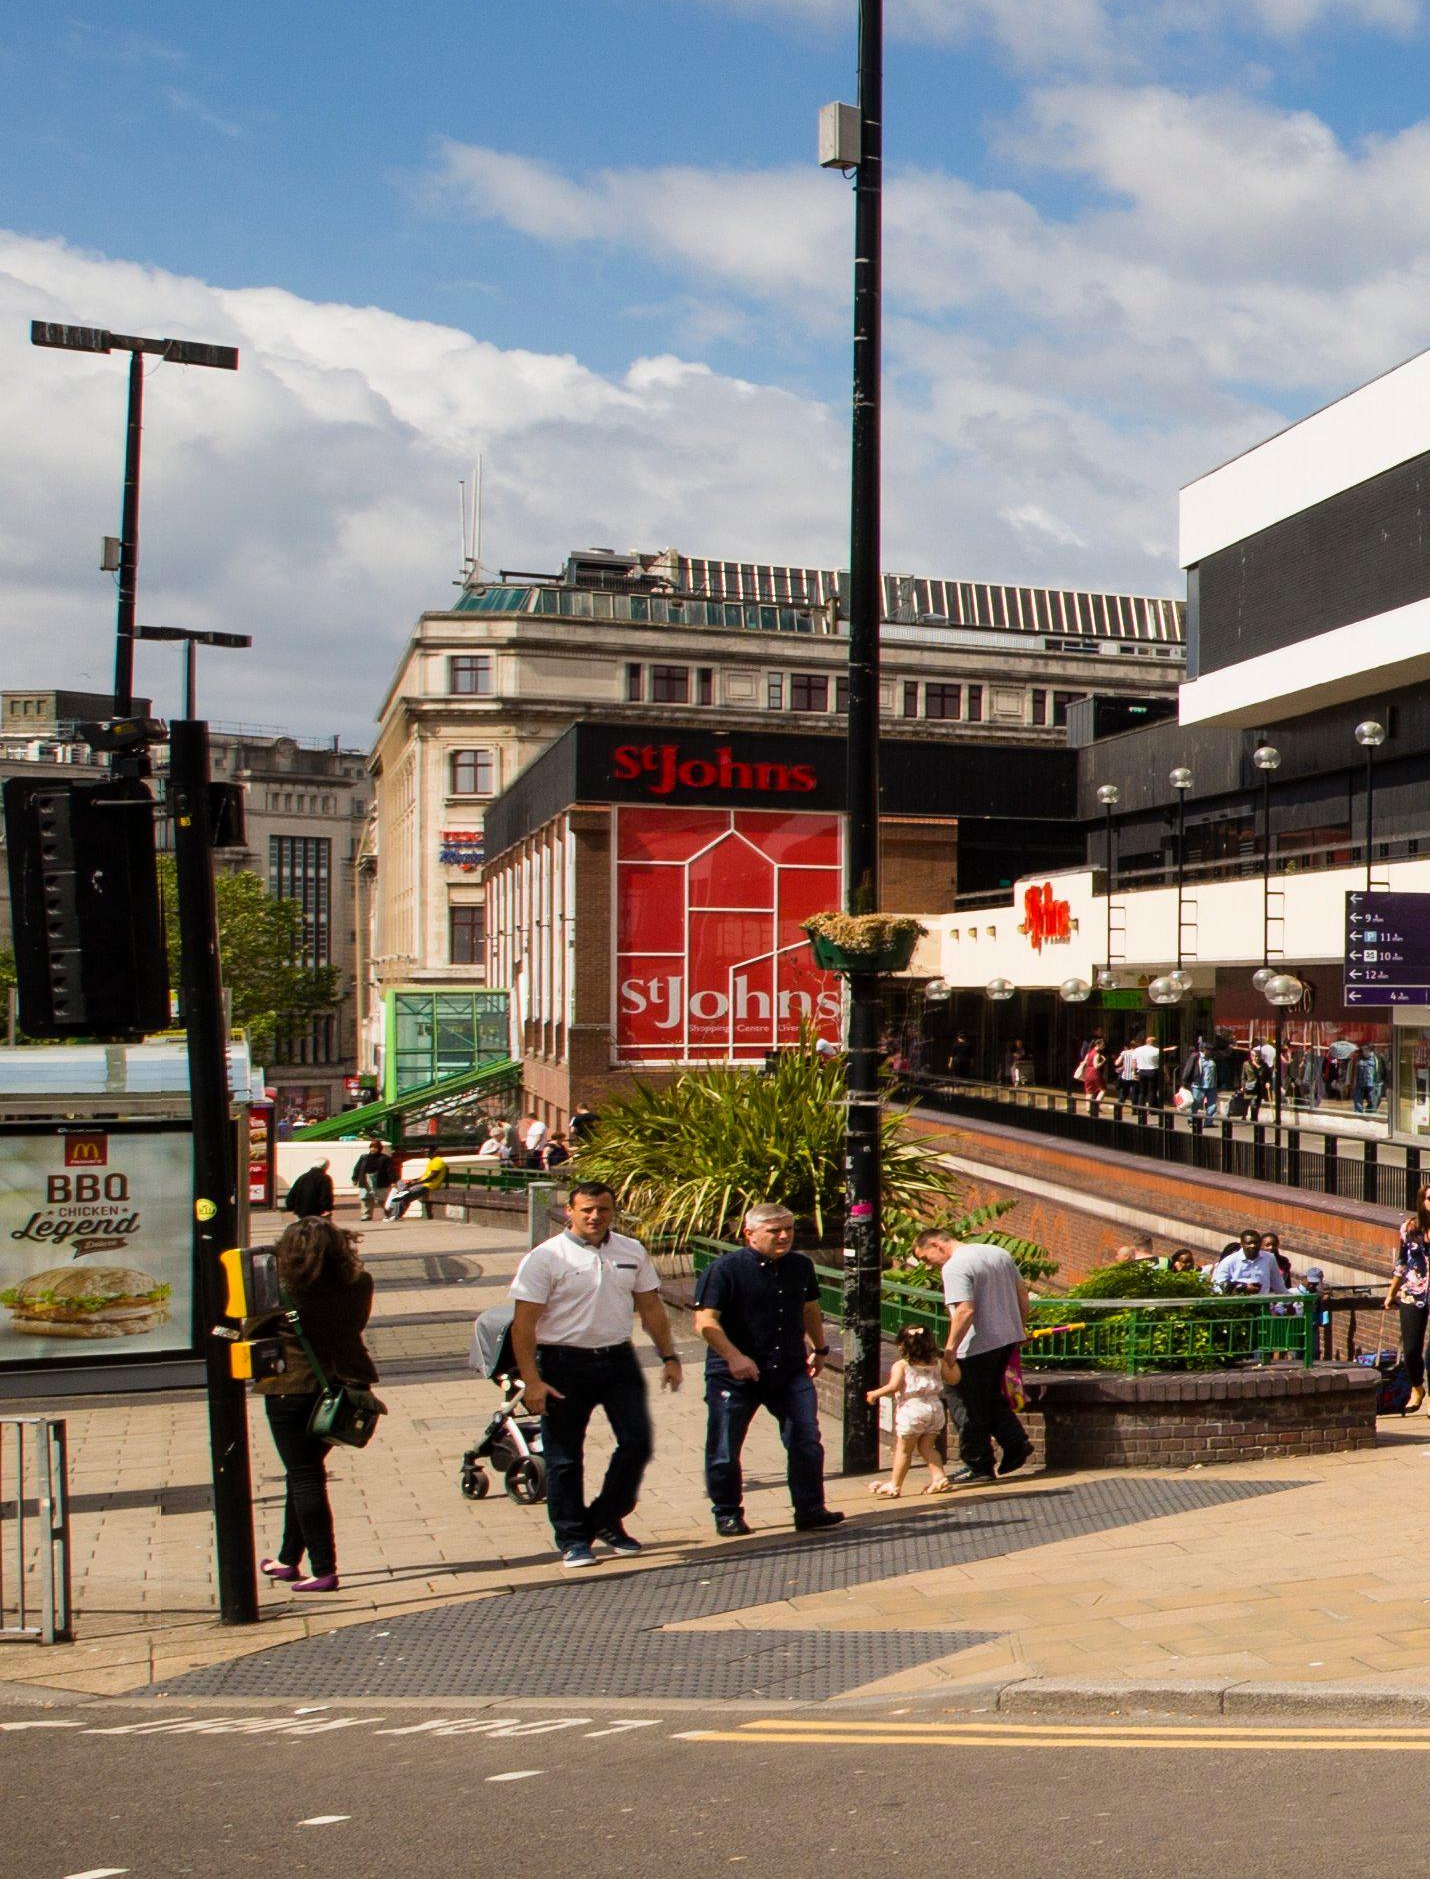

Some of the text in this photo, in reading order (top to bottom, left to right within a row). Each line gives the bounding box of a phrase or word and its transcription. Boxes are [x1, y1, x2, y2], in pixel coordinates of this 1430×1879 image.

[1365, 914, 1371, 922] 9
[1381, 933, 1391, 942] 11
[1380, 953, 1391, 961] 10
[1365, 971, 1376, 979] 12
[1390, 992, 1396, 1000] 4
[47, 1173, 130, 1203] BBQ
[59, 1206, 118, 1217] CHICKEN
[11, 1212, 140, 1245] Legend
